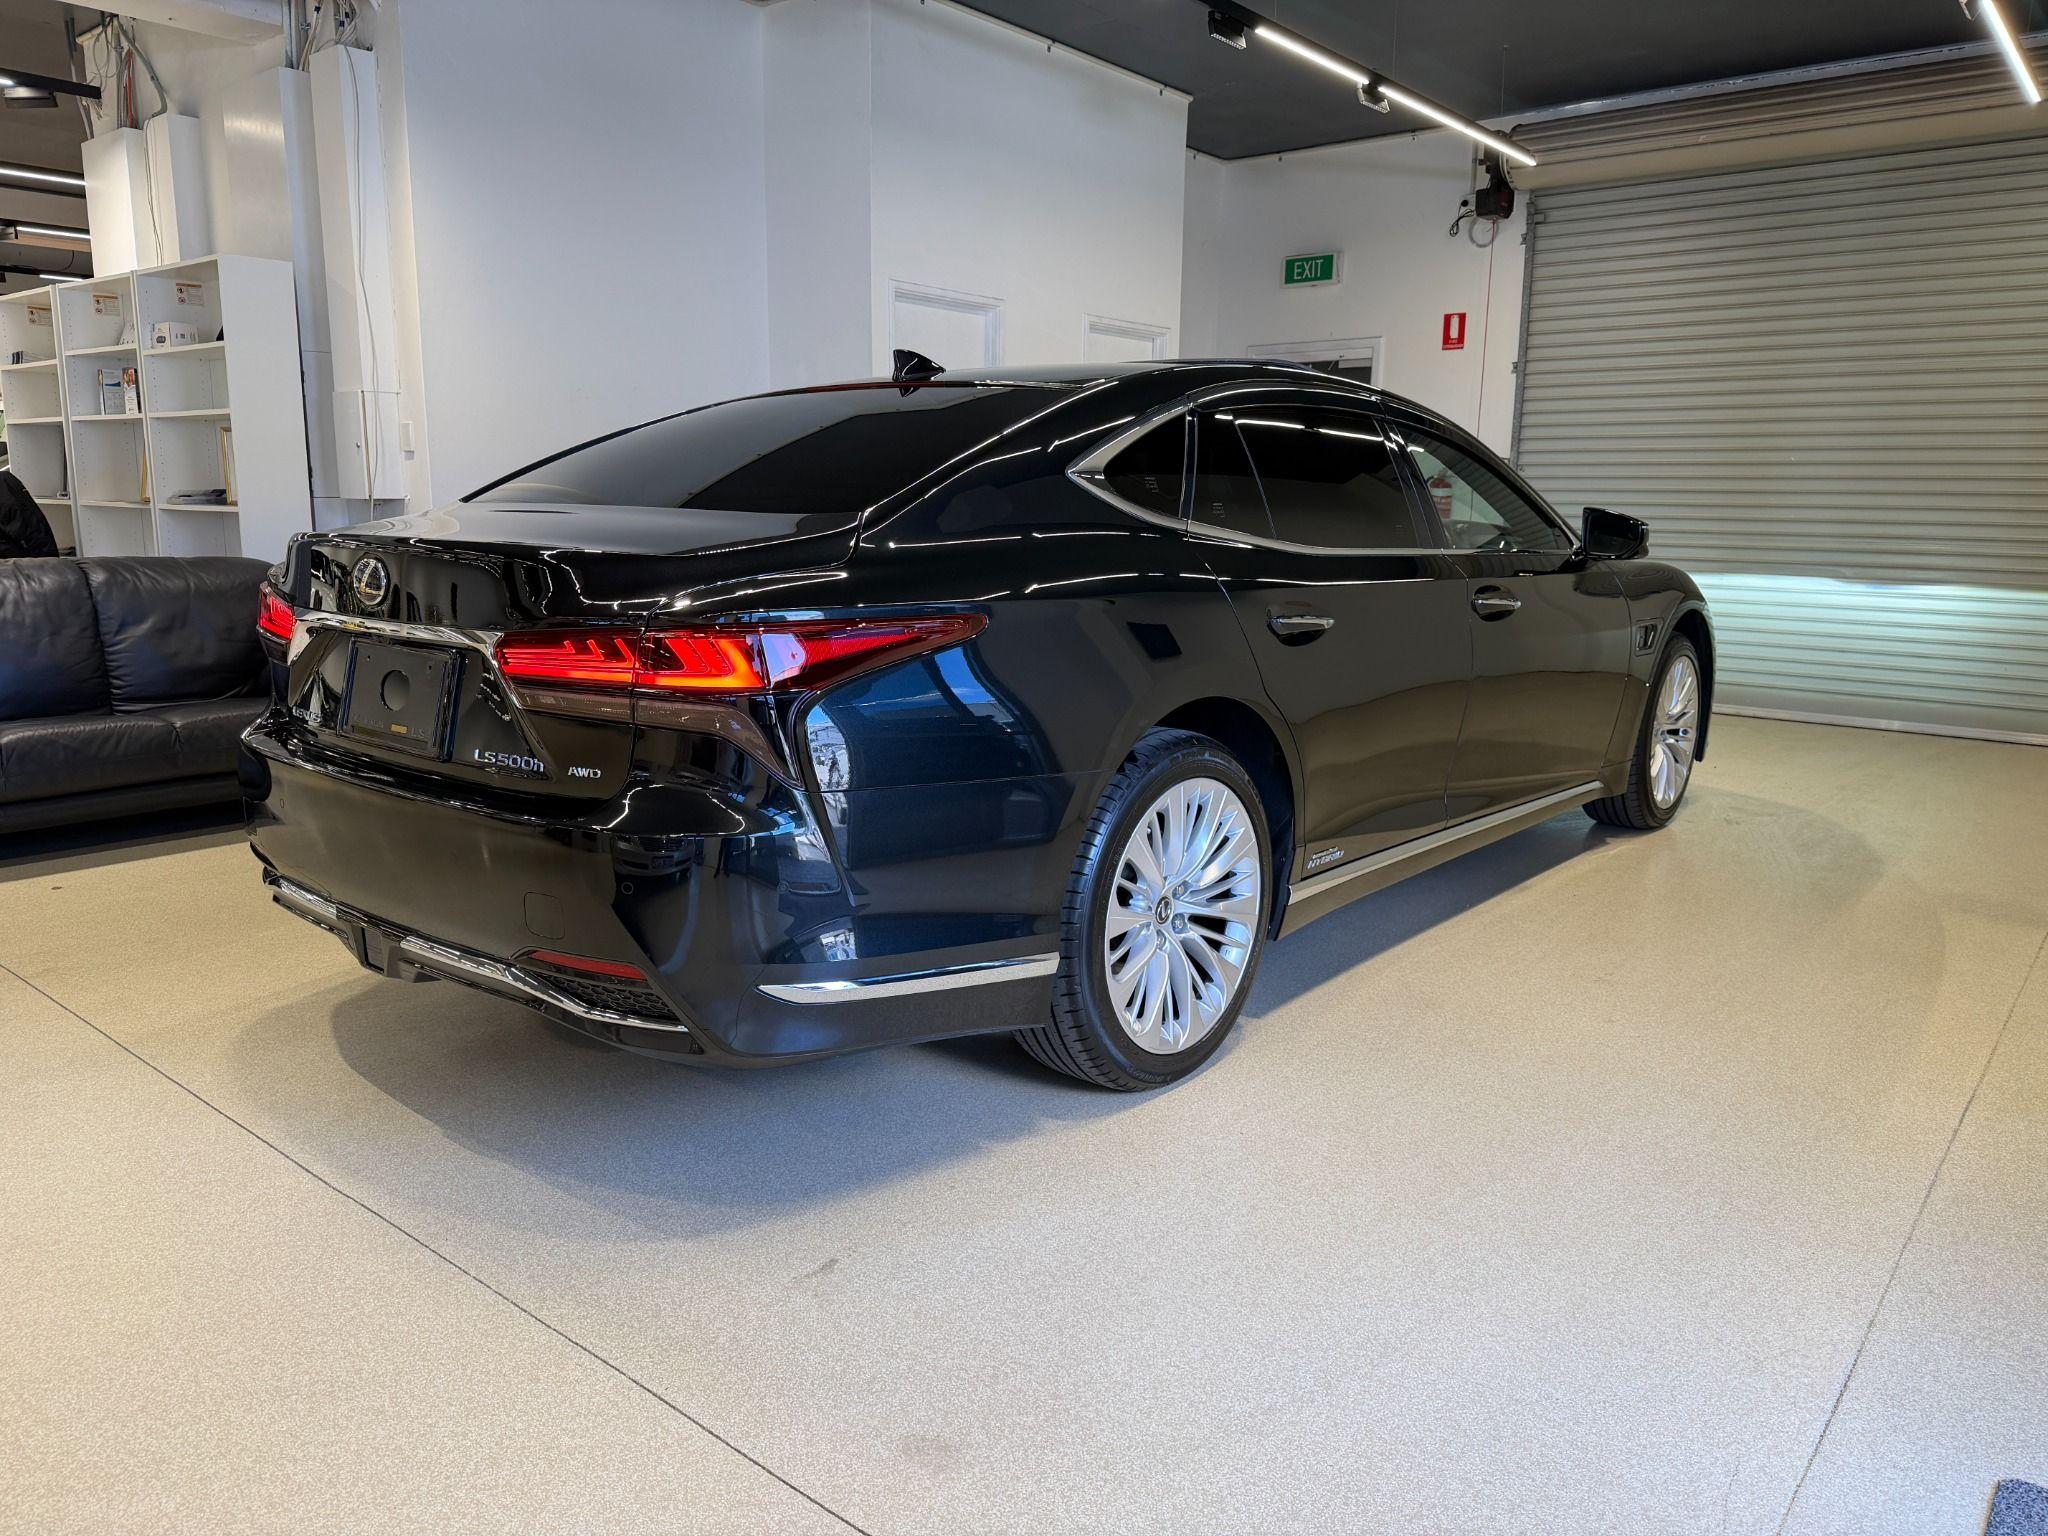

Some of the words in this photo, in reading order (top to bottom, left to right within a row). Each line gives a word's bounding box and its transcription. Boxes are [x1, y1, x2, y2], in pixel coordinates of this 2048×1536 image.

[1294, 259, 1324, 279] EXIT
[474, 748, 544, 773] LS500h
[567, 766, 601, 779] AWD
